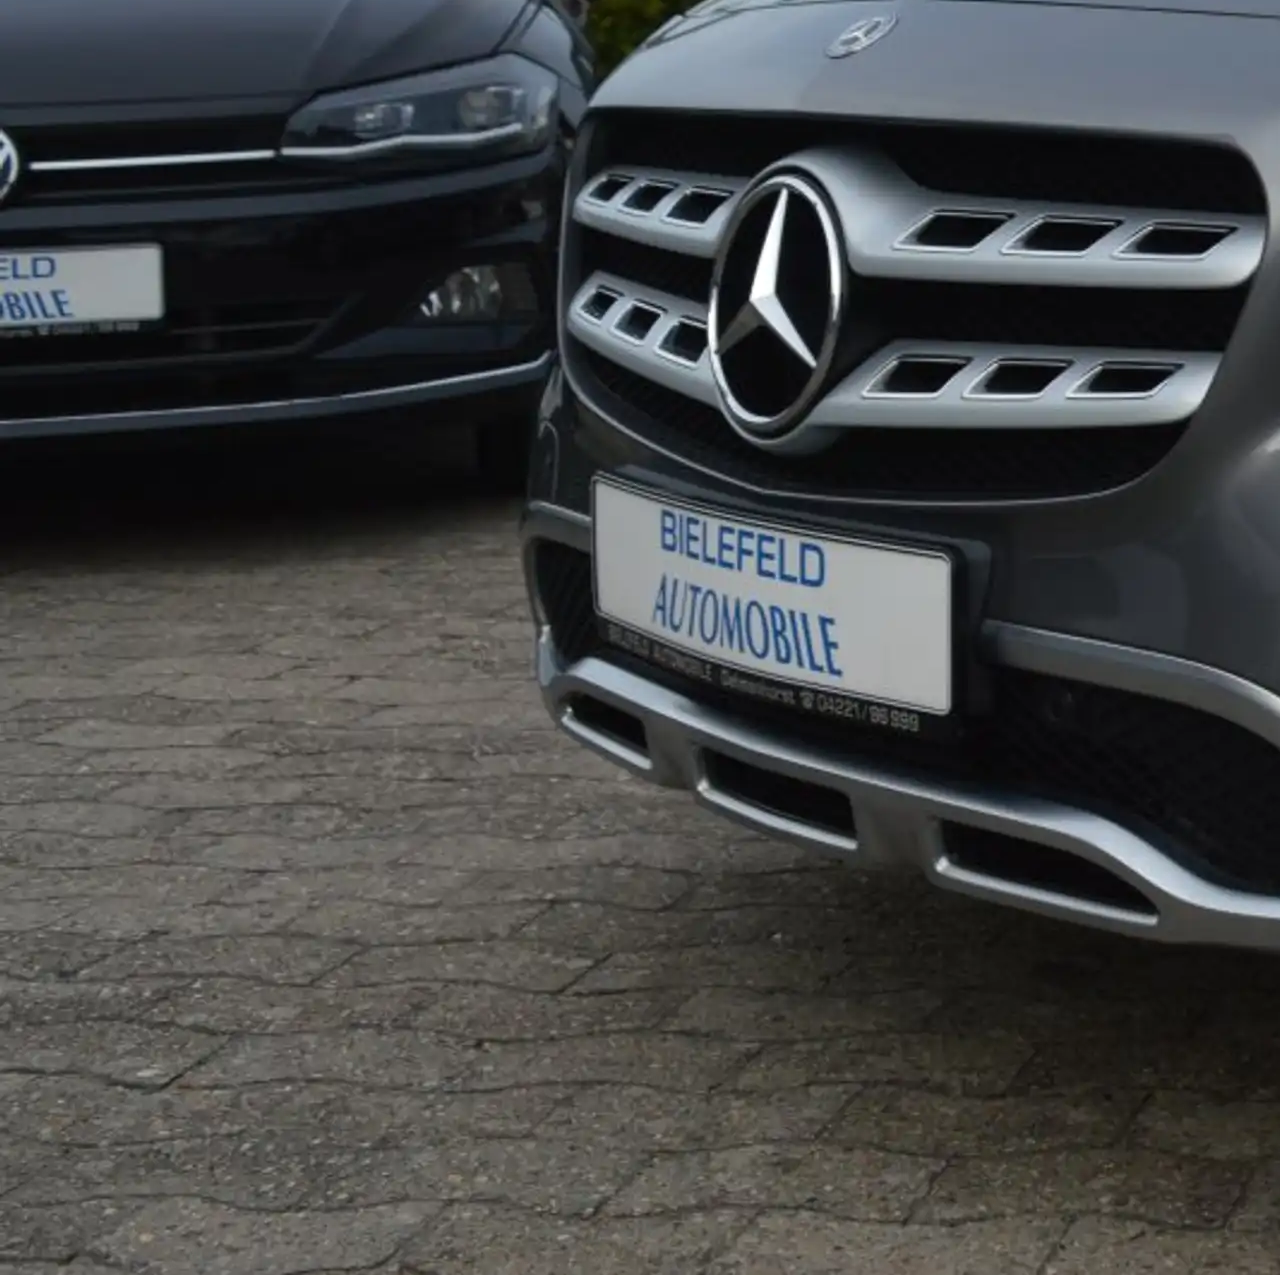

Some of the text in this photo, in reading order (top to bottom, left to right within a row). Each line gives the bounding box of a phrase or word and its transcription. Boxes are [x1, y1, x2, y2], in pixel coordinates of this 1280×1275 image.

[0, 289, 74, 321] BILE
[660, 510, 826, 588] BIELEFELD
[653, 572, 843, 677] AUTOMOBILE
